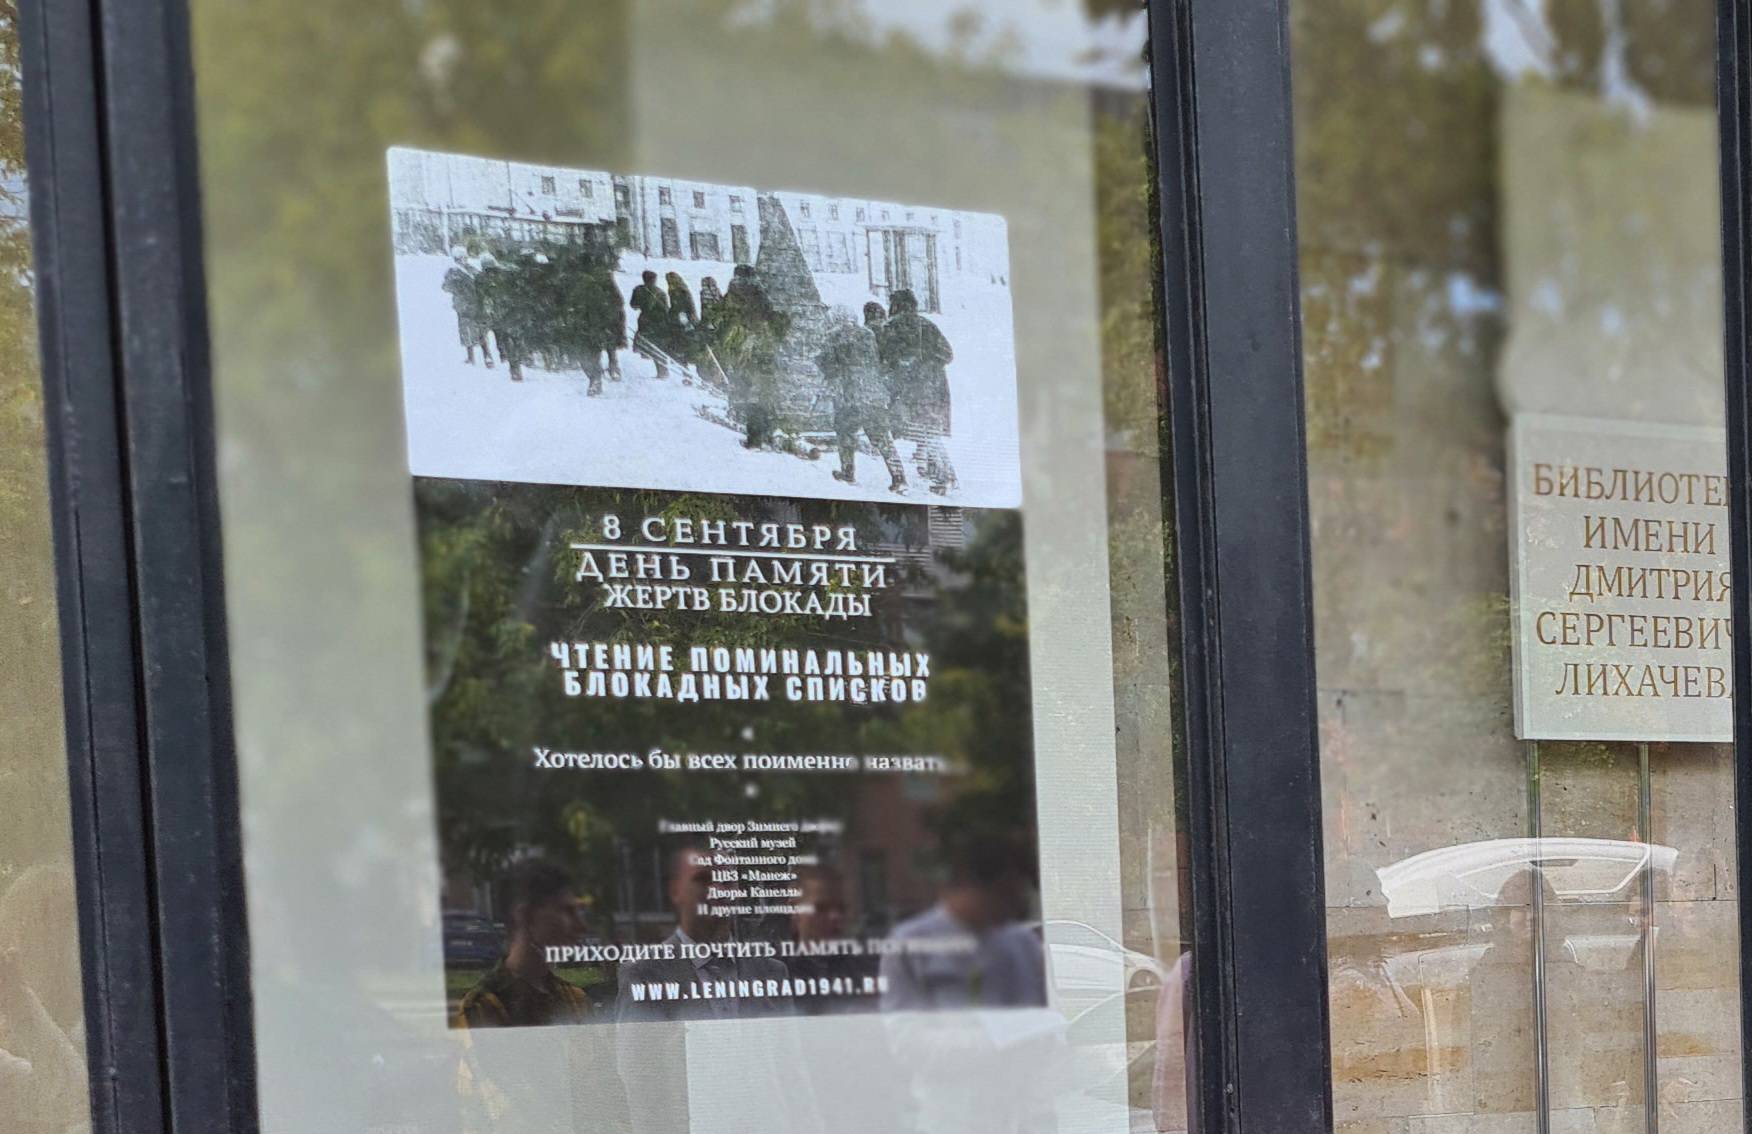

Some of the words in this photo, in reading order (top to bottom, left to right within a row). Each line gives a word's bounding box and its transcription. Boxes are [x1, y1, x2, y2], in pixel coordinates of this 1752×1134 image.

[1533, 463, 1729, 507] БИБЛИОТЕ
[603, 515, 621, 540] 8
[642, 517, 857, 551] СЕНТЯБРЯ
[1583, 515, 1717, 556] ИМЕНИ
[576, 551, 691, 583] ДЕНЬ
[710, 556, 887, 589] ПАМЯТИ
[1568, 564, 1731, 603] ДМИТРИЯ
[603, 583, 711, 611] ЖЕРТВ
[719, 588, 873, 620] БЛОКАДЫ
[550, 641, 674, 671] ЧТЕНИЕ
[690, 646, 930, 677] ПОМИНАЛЬНЫХ
[563, 670, 769, 702] БЛОКАДНЫХ
[786, 675, 928, 702] СПИСКОВ
[1555, 662, 1732, 698] ЛИХАЧЕВ
[533, 748, 643, 769] Хотелось
[648, 748, 681, 769] бы
[687, 752, 737, 770] всех
[743, 753, 858, 770] поименно
[710, 837, 758, 850] Русский
[760, 836, 797, 850] музей
[714, 853, 786, 866] Фонтанного
[712, 869, 739, 882] ЦВЗ
[707, 886, 748, 900] Дворы
[545, 943, 676, 965] ПРИХОДИТЕ
[681, 940, 776, 960] ПОЧТИТЬ
[781, 939, 863, 957] ПАМЯТЬ
[631, 976, 889, 1001] WWW.LENINGRAD1941.RU
